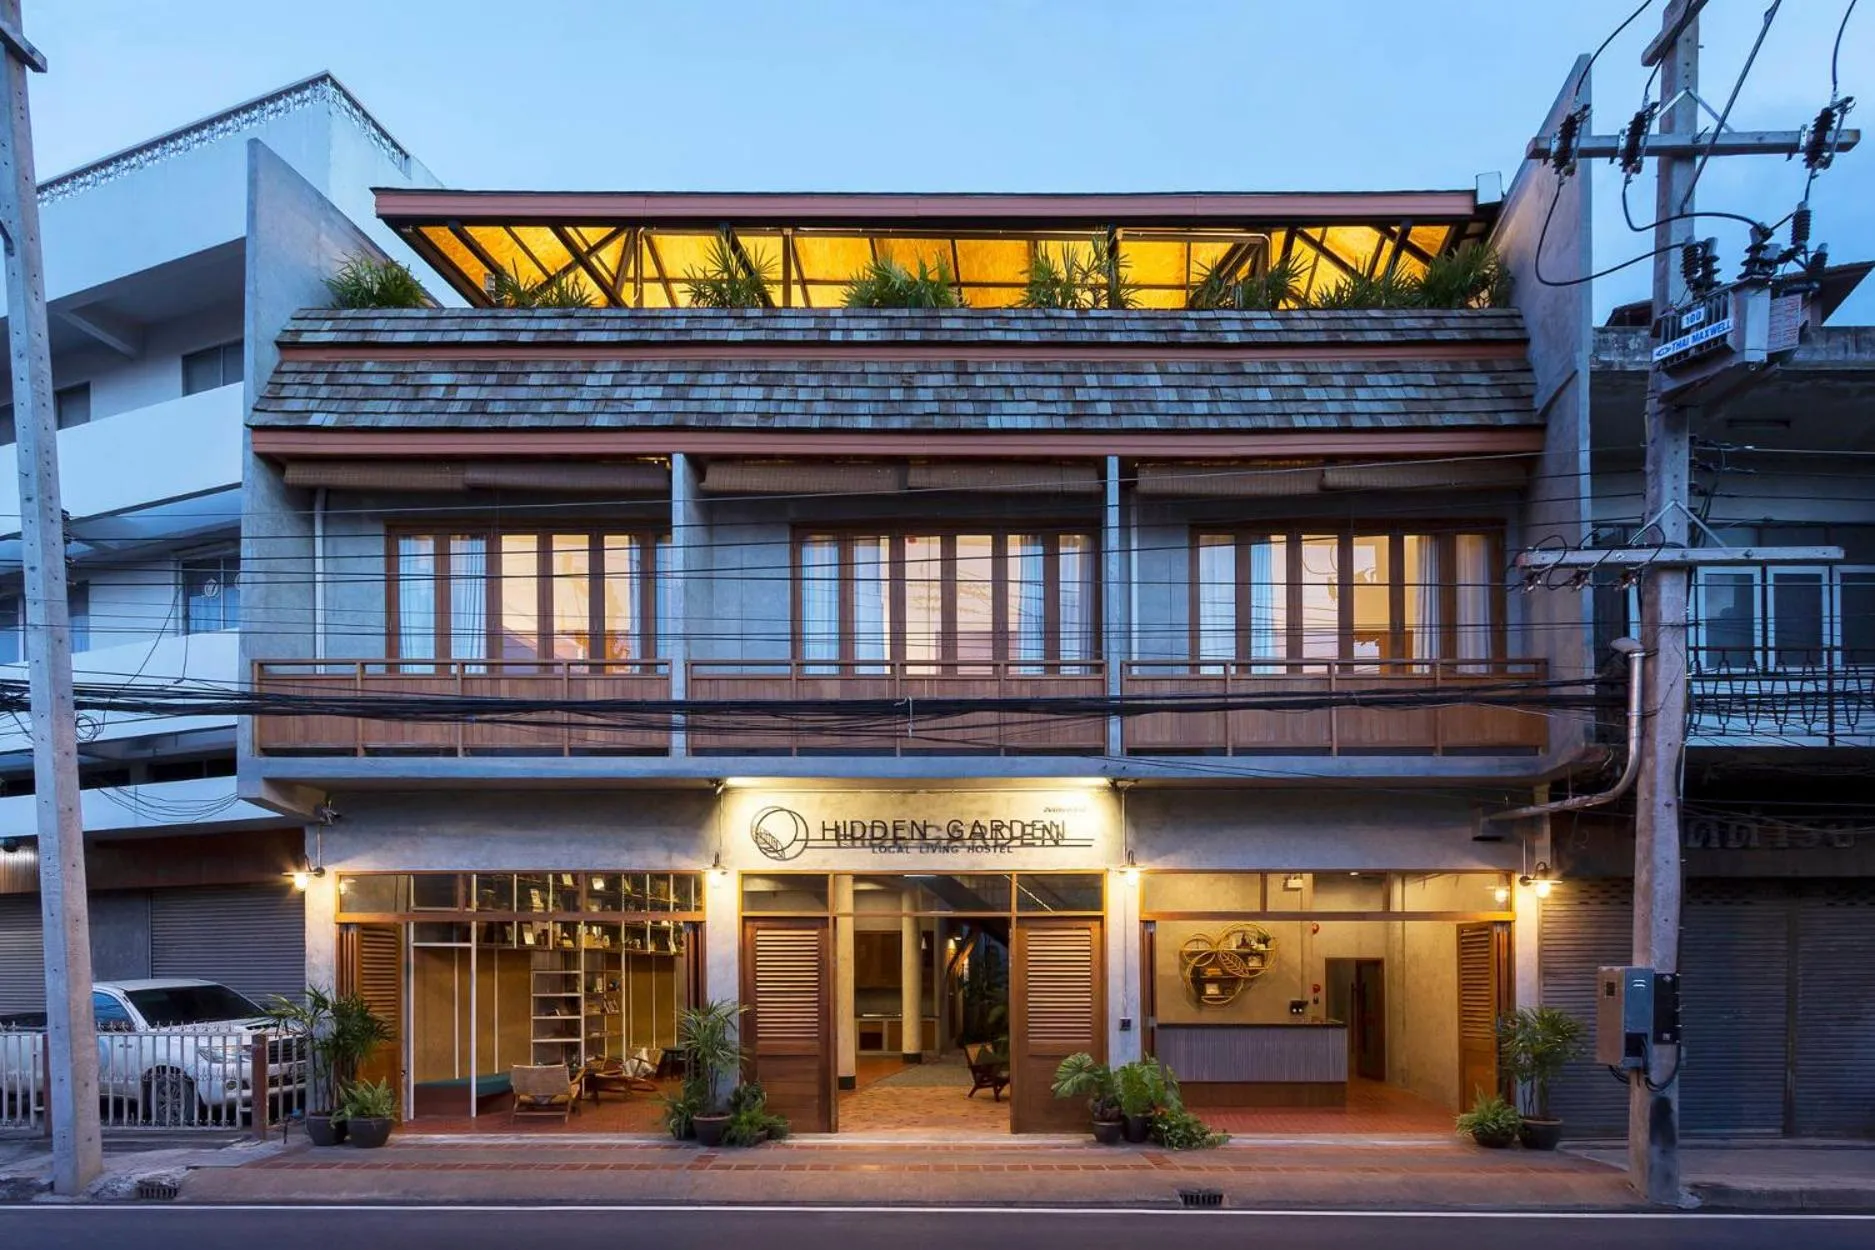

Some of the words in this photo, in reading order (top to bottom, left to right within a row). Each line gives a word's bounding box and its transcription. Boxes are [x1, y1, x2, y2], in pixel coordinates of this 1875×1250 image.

[1672, 337, 1690, 351] THAI
[1692, 319, 1732, 343] MAXWELL
[821, 819, 927, 840] HIDDEN
[946, 819, 1066, 840] GARDEN
[871, 845, 910, 855] LOCAL
[919, 844, 960, 855] LIVING
[967, 844, 1014, 854] HOSTEL
